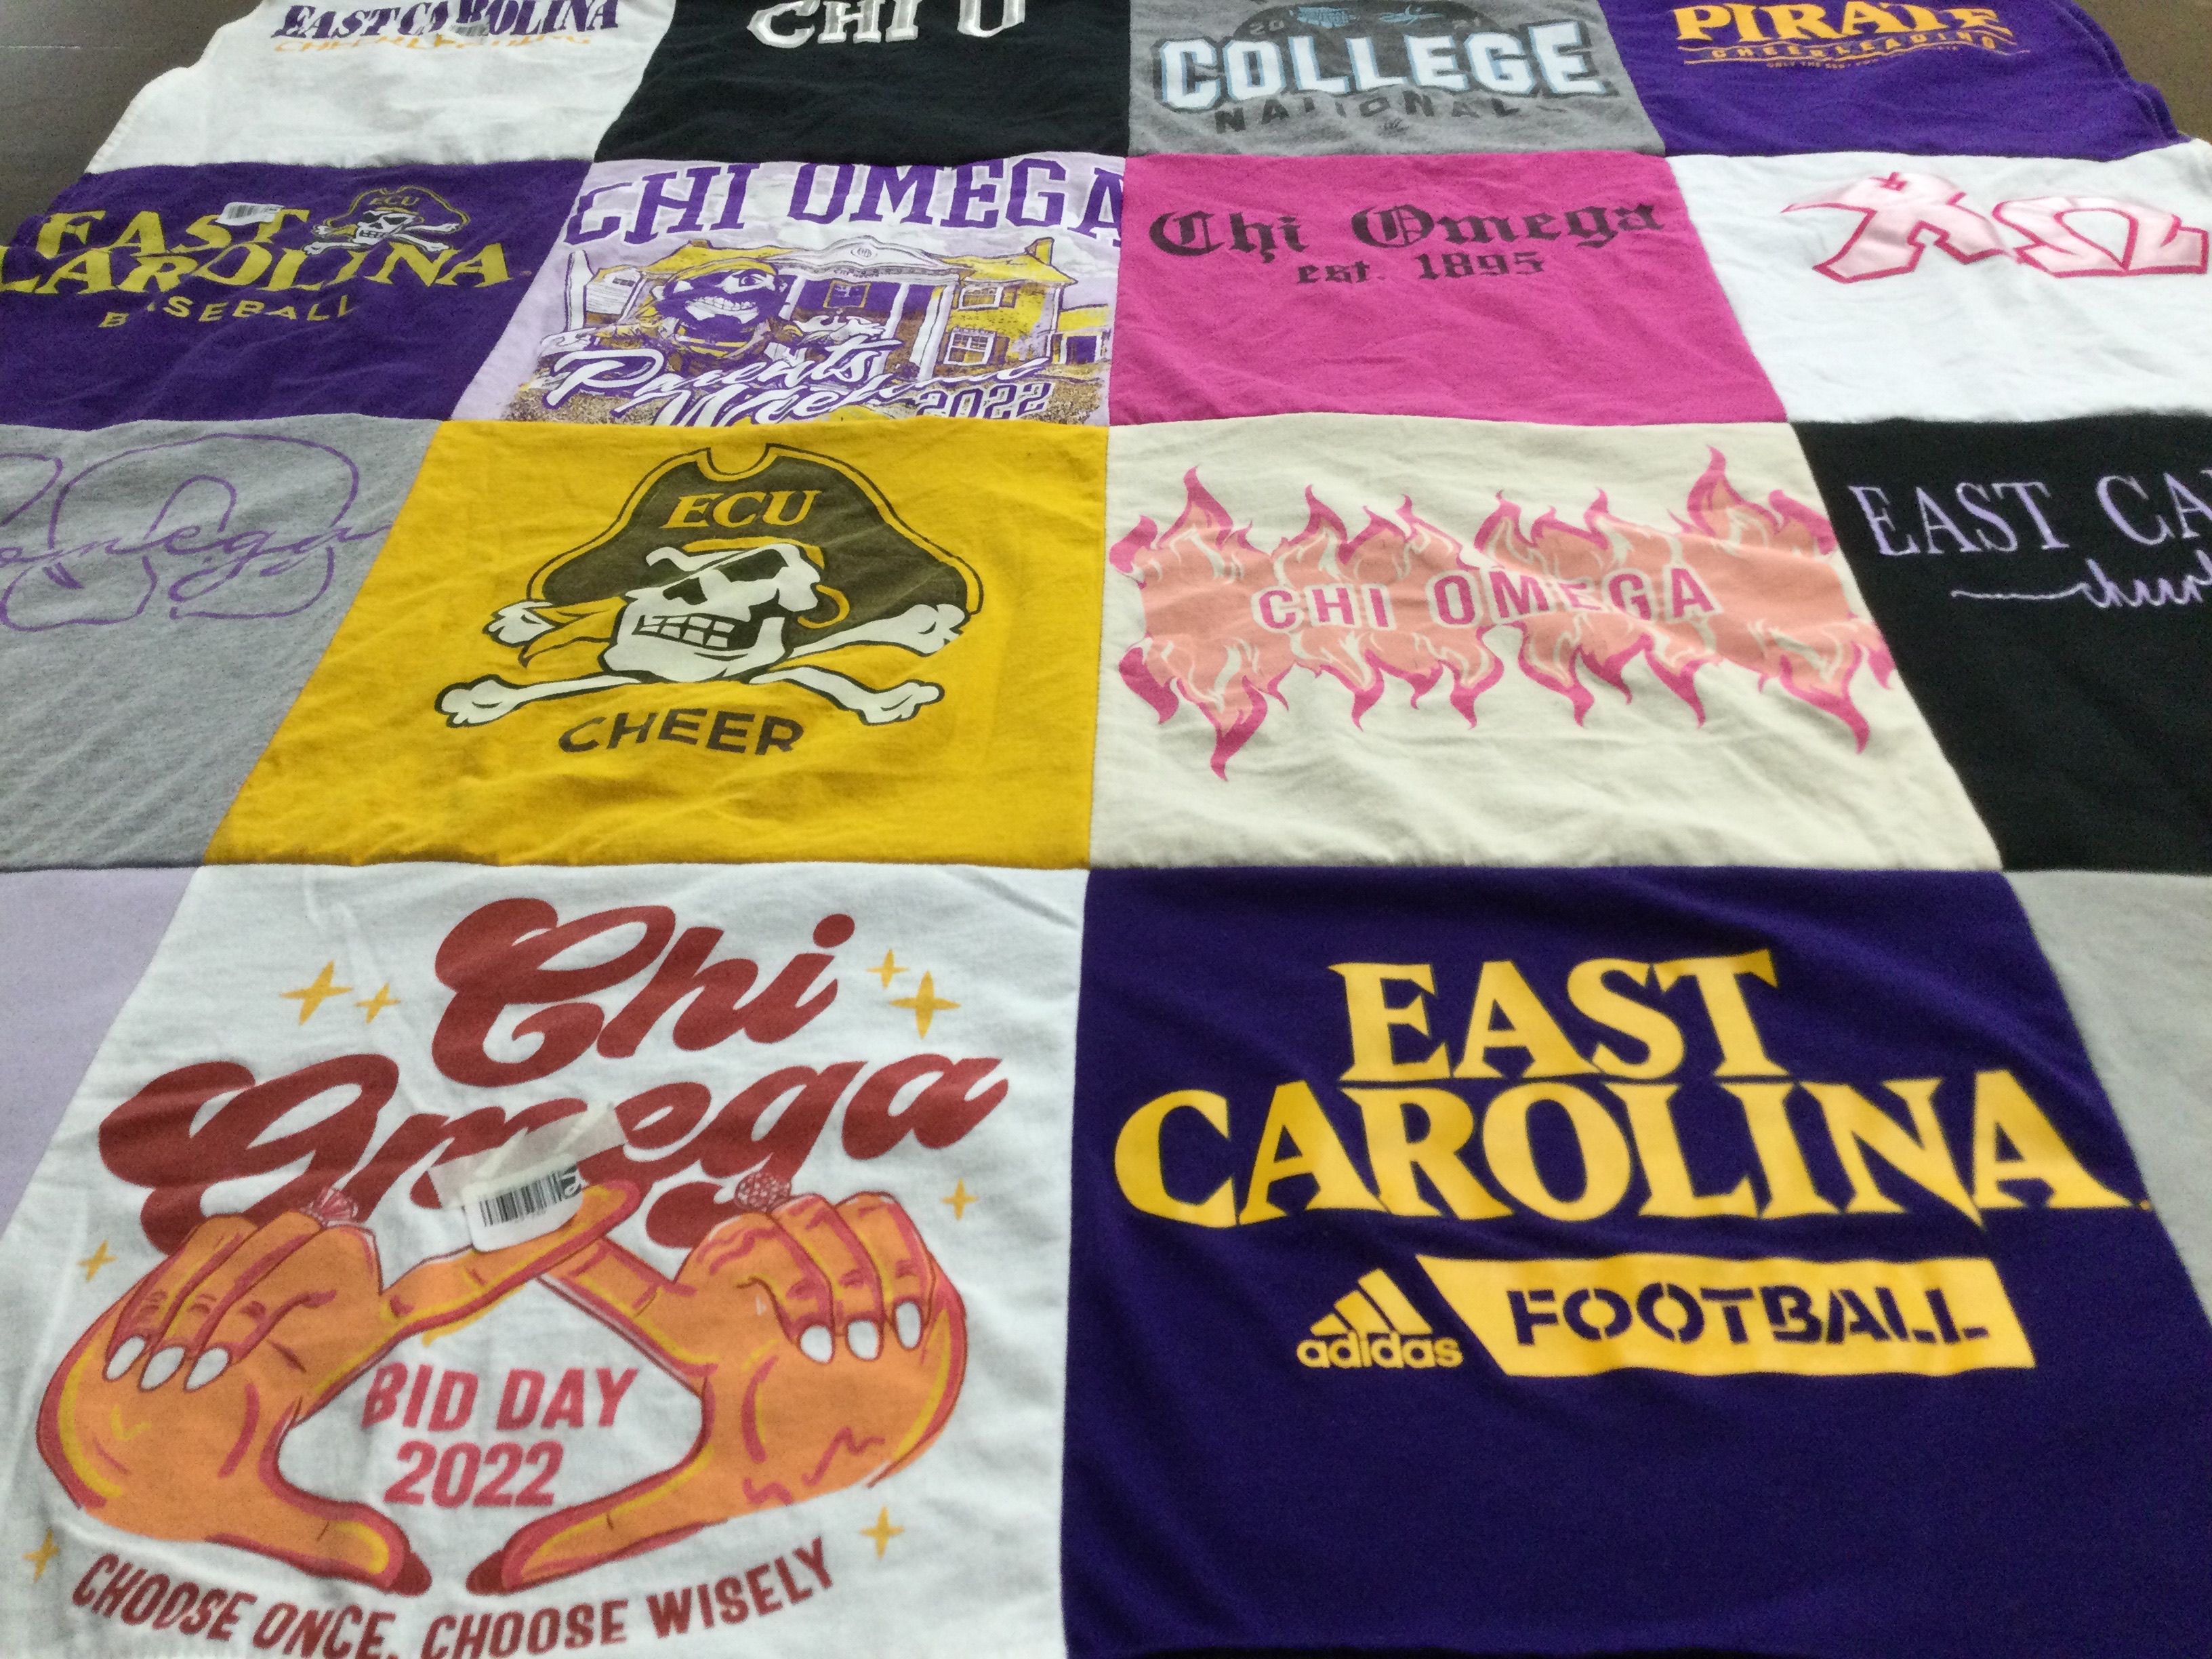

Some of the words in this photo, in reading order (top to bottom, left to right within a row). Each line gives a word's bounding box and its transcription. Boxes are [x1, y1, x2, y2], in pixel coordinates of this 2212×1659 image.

[270, 5, 401, 39] EAST
[398, 0, 618, 35] CAROLINA
[747, 0, 918, 49] CHI
[1672, 1, 2013, 41] PIRATE
[1157, 20, 1608, 112] COLLEGE
[37, 209, 310, 258] EAST
[563, 163, 761, 245] CHI
[787, 159, 1125, 248] OMEGA
[1149, 210, 1307, 264] Chi
[1351, 202, 1666, 249] Omega
[1414, 251, 1545, 280] 1895
[98, 294, 357, 329] BSEBALL
[916, 382, 1055, 419] 2022
[660, 490, 821, 529] ECU
[1847, 480, 2070, 556] EAST
[2096, 468, 2212, 546] CA
[1258, 588, 1391, 630] CHI
[1433, 566, 1717, 626] OMEGA
[558, 708, 805, 756] CHEER
[431, 897, 857, 1086] Chi
[1326, 948, 1792, 1082] EAST
[98, 1053, 1010, 1256] Omega
[1113, 1069, 2136, 1231] CAROLINA
[1296, 1330, 1465, 1369] adidas
[1505, 1282, 1991, 1346] FOOTBALL
[361, 1361, 478, 1432] BID
[495, 1368, 640, 1431] DAY
[383, 1439, 565, 1509] 2022
[72, 1553, 258, 1641] CHOOSE
[420, 1597, 630, 1659] CHOOSE
[646, 1536, 834, 1639] WISELY
